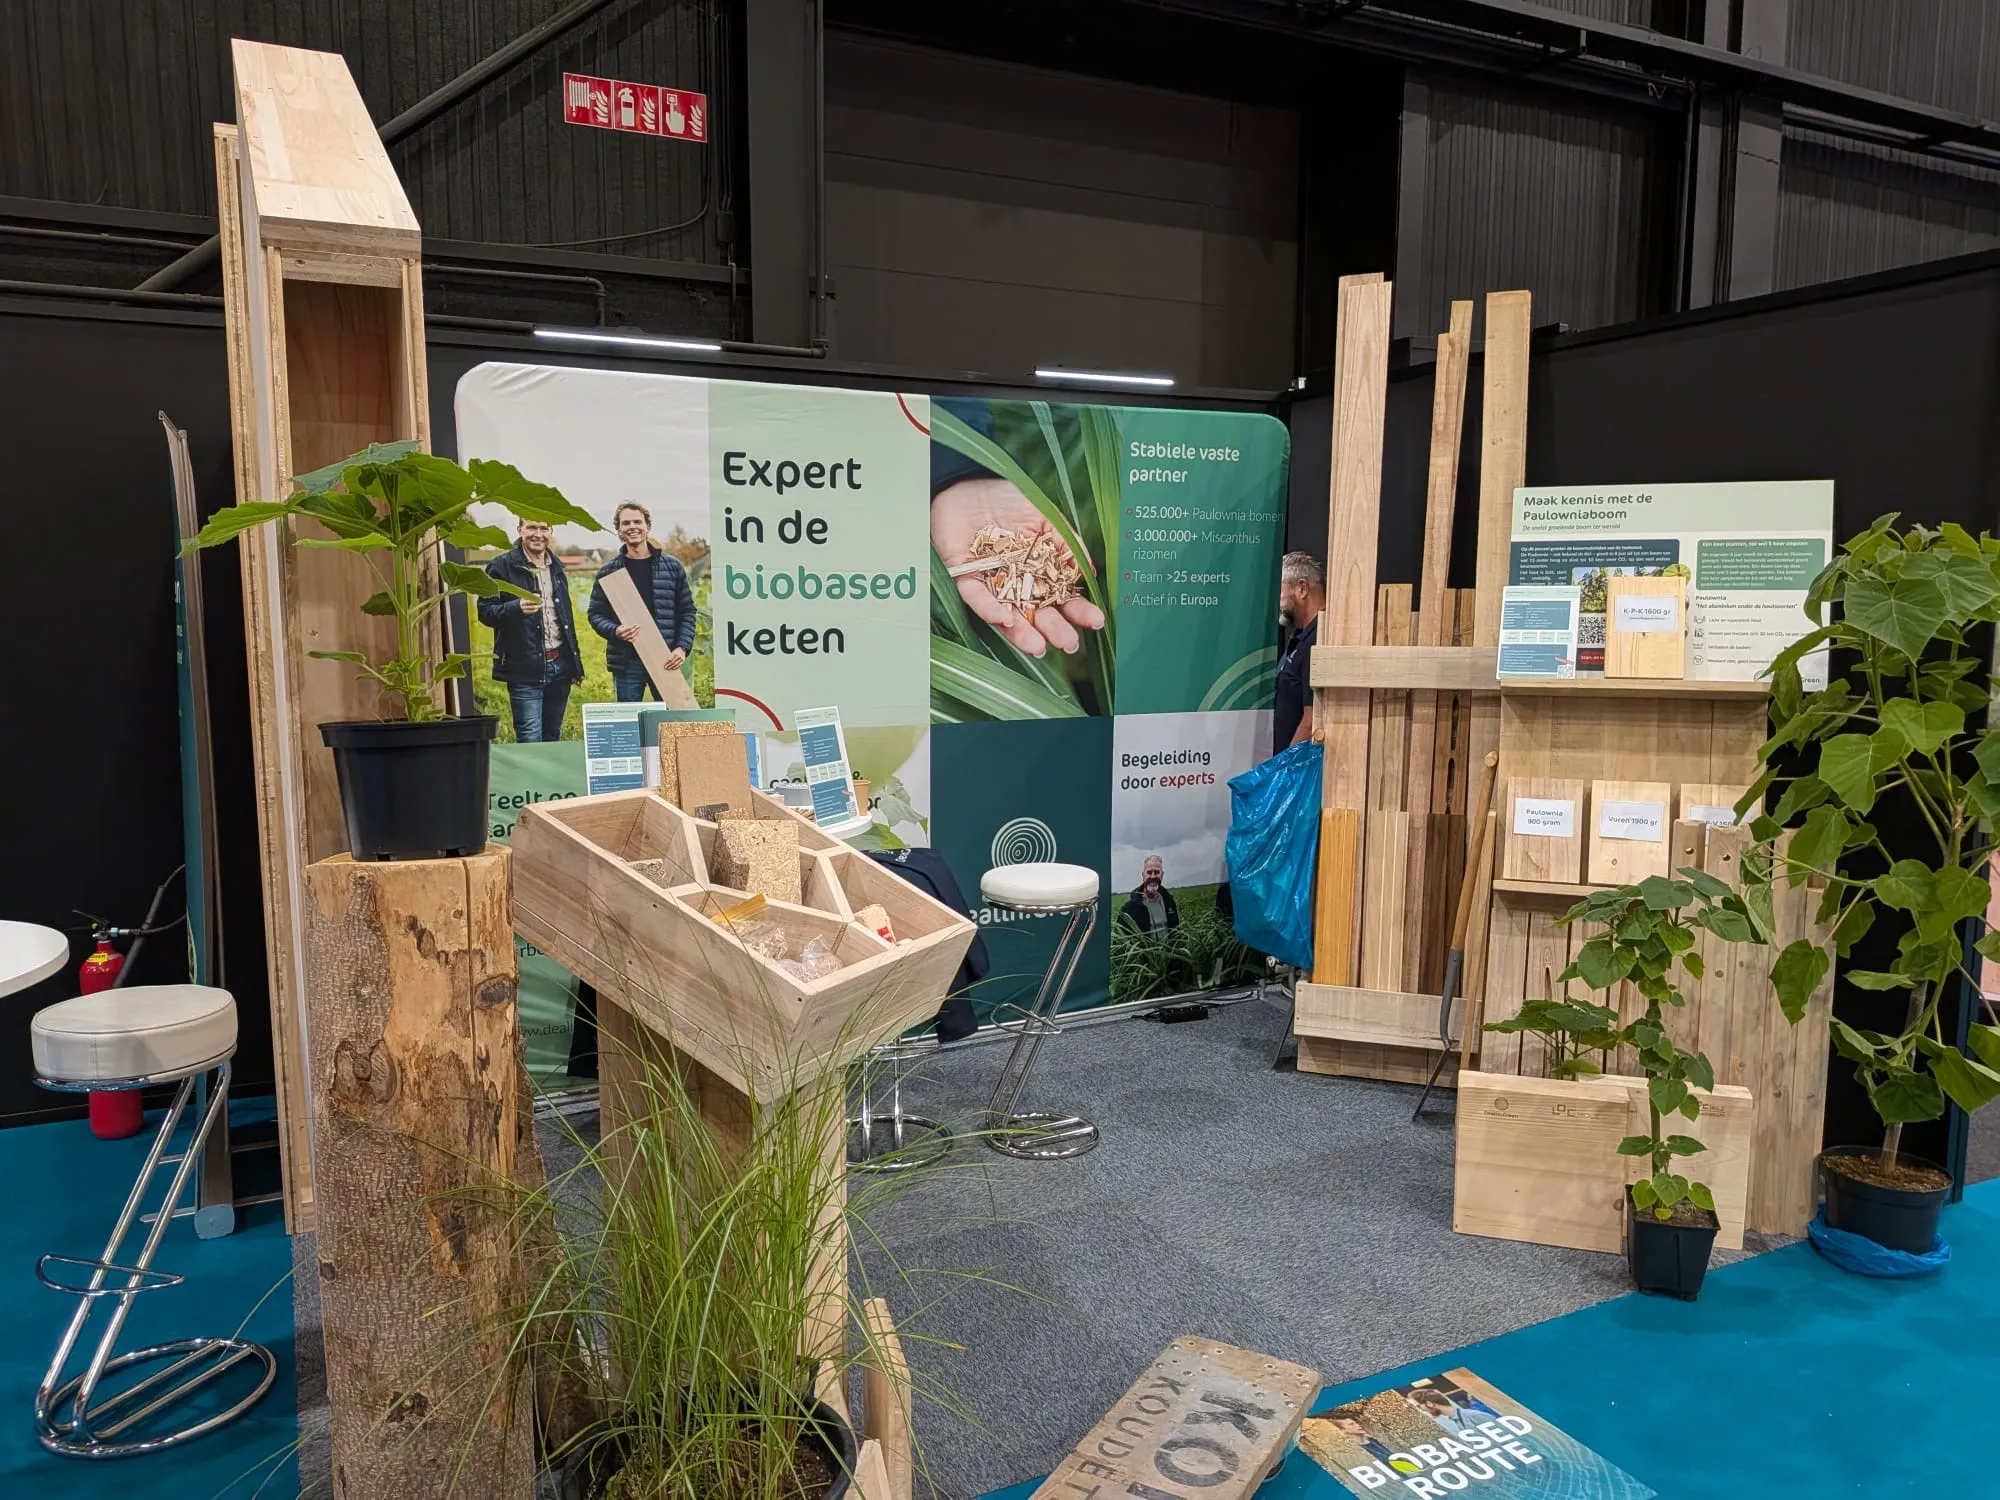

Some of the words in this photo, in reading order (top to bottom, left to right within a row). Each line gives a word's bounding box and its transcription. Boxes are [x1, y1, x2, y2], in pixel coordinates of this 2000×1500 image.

[1129, 441, 1196, 460] Stabiele
[1199, 447, 1240, 462] vaste
[723, 451, 862, 495] Expert
[1129, 467, 1188, 484] partner
[1523, 495, 1558, 506] Maak
[1561, 494, 1604, 506] kennis
[1607, 494, 1633, 505] met
[1636, 493, 1653, 504] de
[1135, 506, 1190, 520] 525.000+
[1192, 507, 1246, 521] Paulownia
[1249, 511, 1285, 523] bomen
[1523, 509, 1627, 521] Paulowniaboom
[724, 508, 764, 543] in
[777, 511, 829, 545] de
[1134, 529, 1198, 543] 3.000.000+
[1201, 531, 1261, 545] Miscanthus
[1133, 548, 1177, 560] rizomen
[725, 564, 917, 600] biobased
[1132, 570, 1163, 583] Team
[1166, 571, 1187, 583] >25
[1190, 572, 1230, 585] experts
[1132, 594, 1165, 606] Actief
[1167, 594, 1177, 605] in
[1180, 594, 1219, 608] Europa
[727, 621, 845, 655] keten
[1121, 749, 1211, 768] Begeleiding
[1120, 775, 1157, 790] door
[1160, 772, 1215, 790] experts
[1526, 808, 1563, 817] Paulownia
[1608, 816, 1630, 825] Vuren
[1631, 817, 1649, 826] 1900
[1542, 819, 1561, 827] gram
[1348, 1414, 1534, 1491] BIOBASED
[1403, 1440, 1543, 1500] ROUTE
